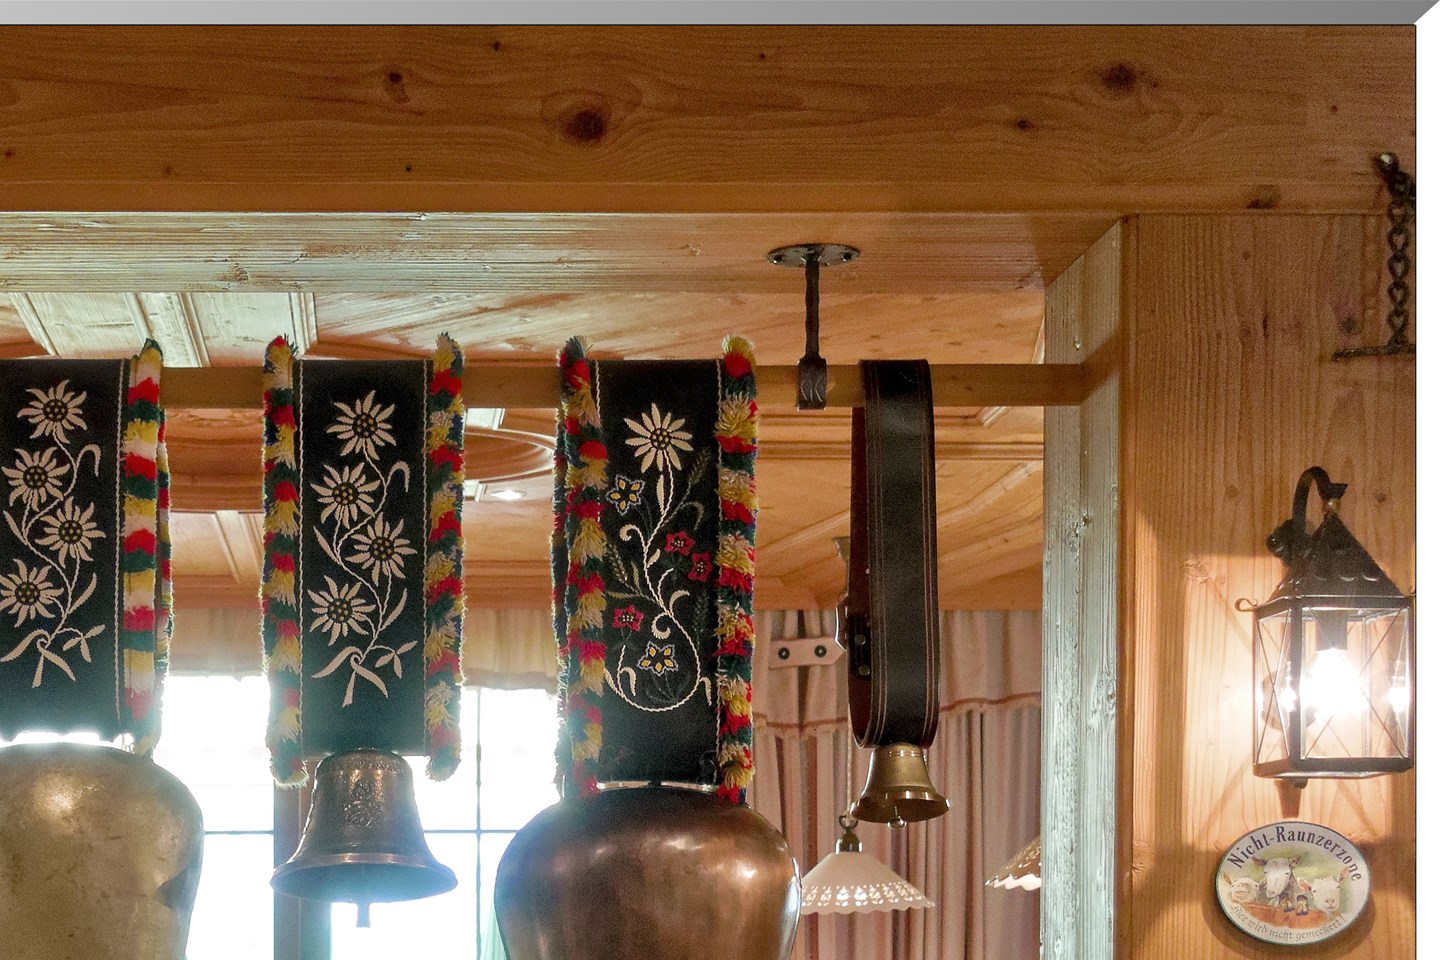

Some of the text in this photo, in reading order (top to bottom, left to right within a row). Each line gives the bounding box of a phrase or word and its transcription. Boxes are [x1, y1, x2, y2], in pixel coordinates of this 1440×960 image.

[1227, 825, 1362, 882] Nicht-Raunzerzone
[1248, 919, 1268, 934] wird
[1269, 930, 1294, 941] nicht
